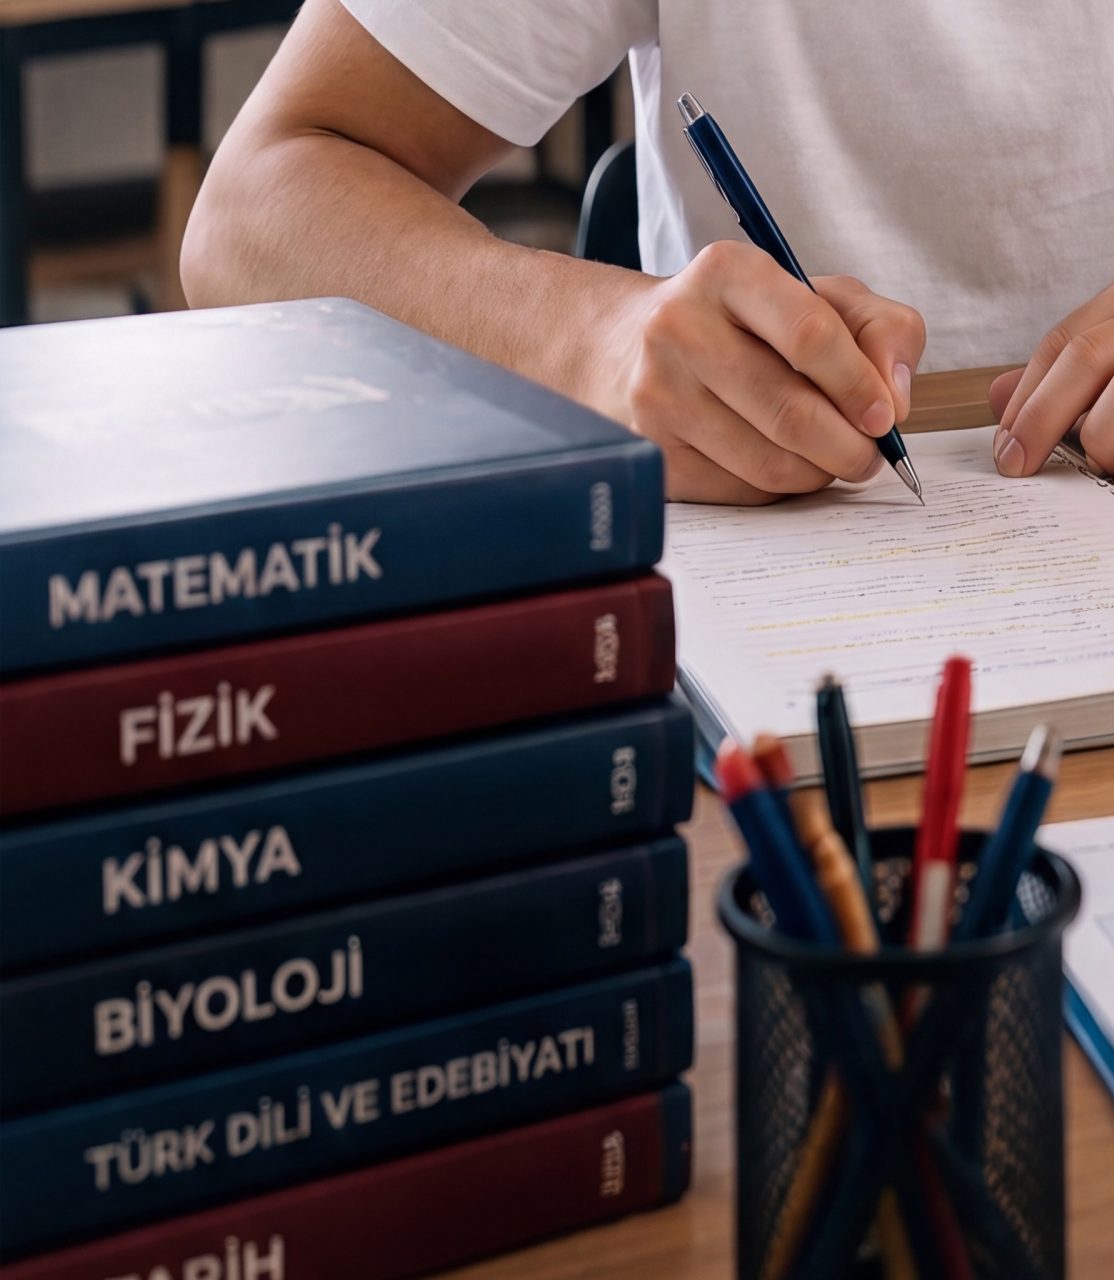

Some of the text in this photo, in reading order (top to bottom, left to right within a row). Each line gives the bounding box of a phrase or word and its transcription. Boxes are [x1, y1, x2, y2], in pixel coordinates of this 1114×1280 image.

[48, 523, 384, 629] MATEMATİK
[118, 682, 278, 765] FİZİK
[101, 825, 302, 914] KİMYA
[93, 935, 364, 1056] BİYOLOJİ
[84, 1121, 216, 1193] TÜRK
[226, 1085, 312, 1156] DİLİ
[320, 1078, 380, 1131] VE
[390, 1027, 595, 1114] EDEBİYATI
